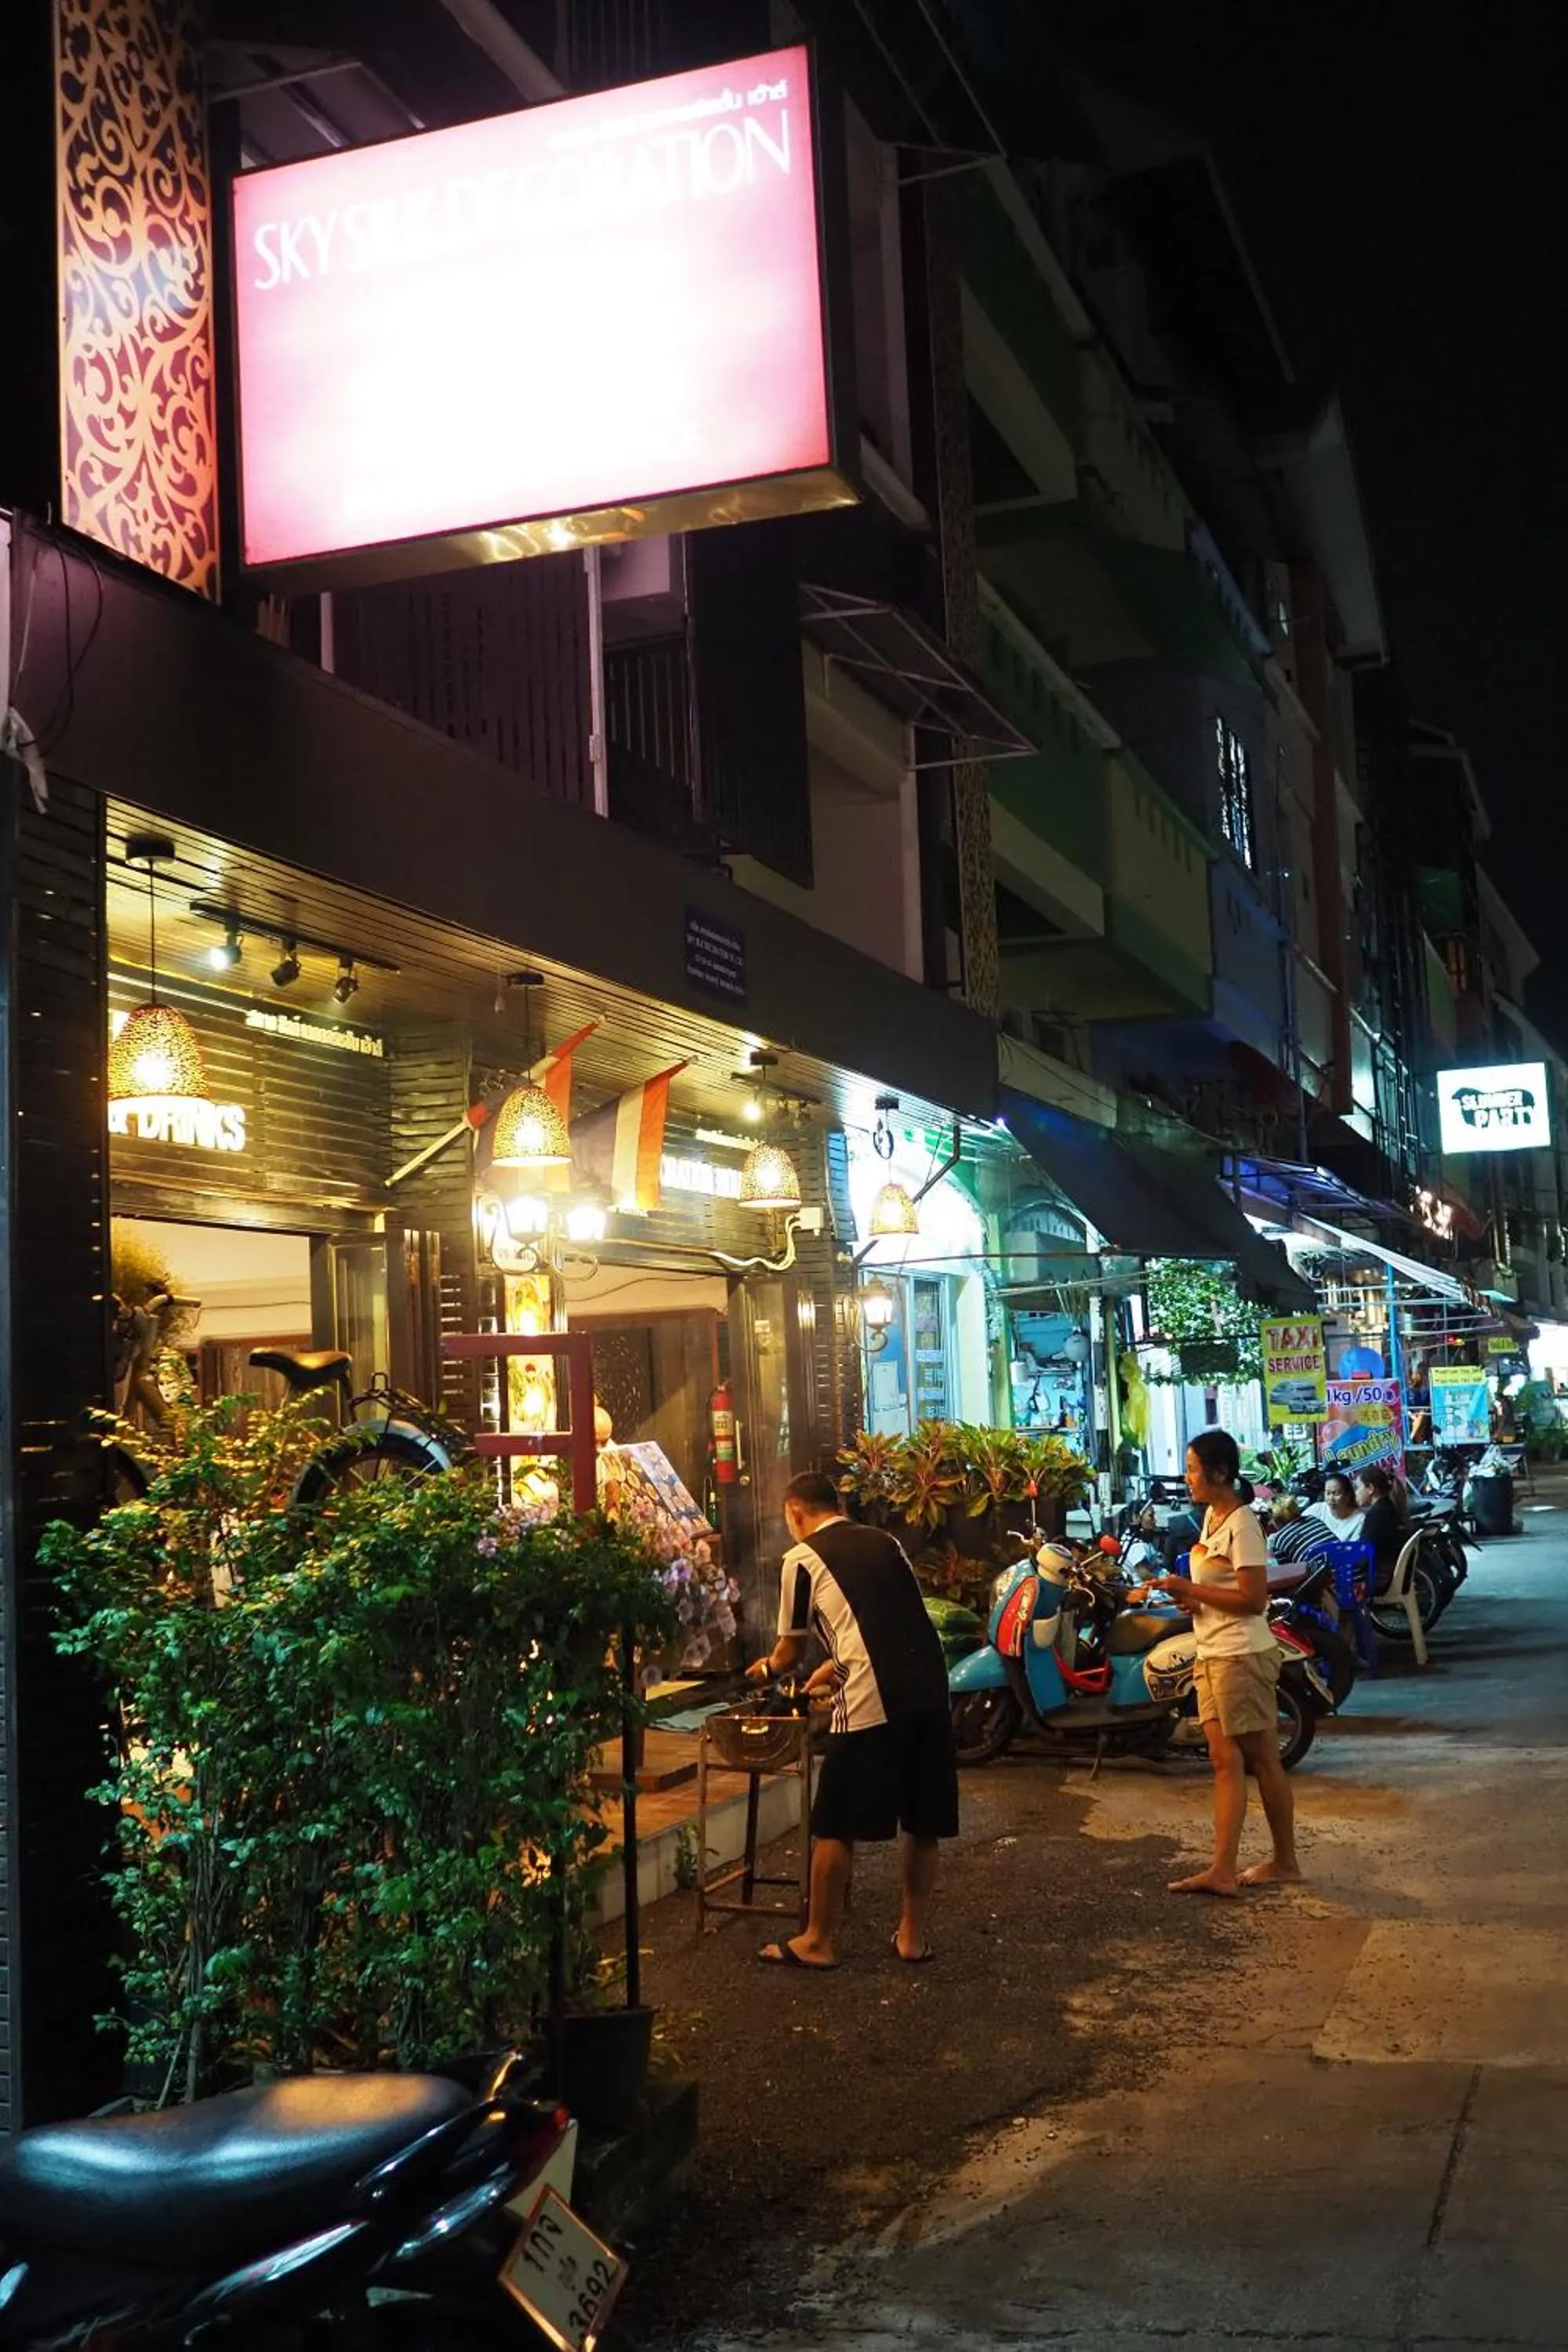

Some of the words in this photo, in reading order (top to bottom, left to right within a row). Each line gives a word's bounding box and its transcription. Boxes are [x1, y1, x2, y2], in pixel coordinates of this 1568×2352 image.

[253, 212, 337, 289] SKY
[447, 108, 790, 238] DECORATION
[138, 1098, 245, 1152] DRINKS
[1266, 1325, 1318, 1352] TAXI
[1268, 1355, 1320, 1373] SERVICE
[568, 2259, 619, 2339] 3692
